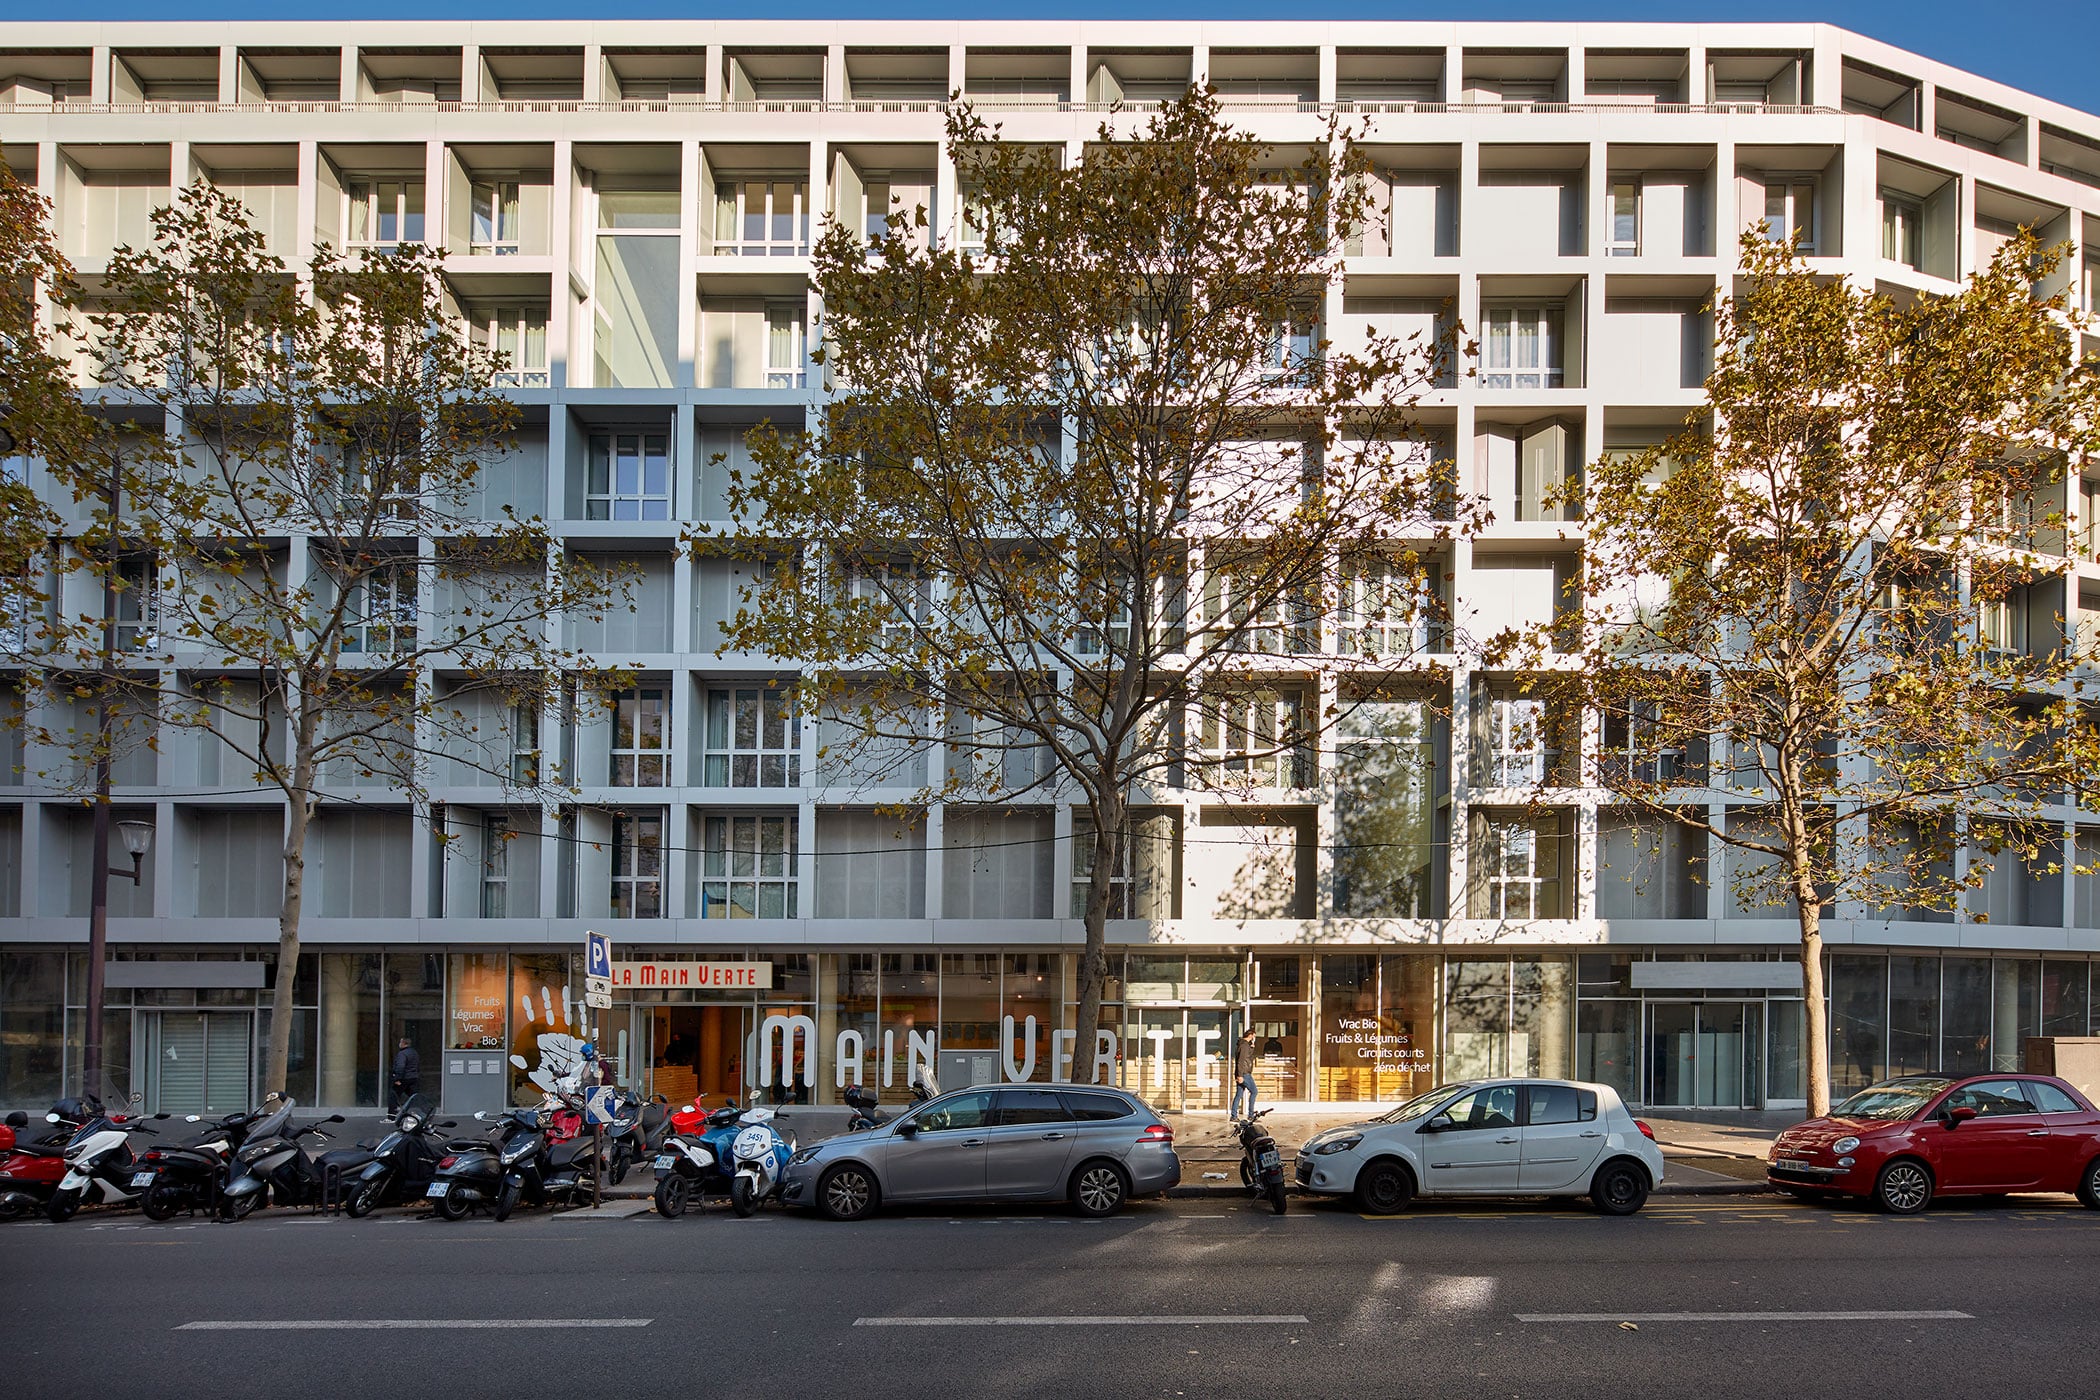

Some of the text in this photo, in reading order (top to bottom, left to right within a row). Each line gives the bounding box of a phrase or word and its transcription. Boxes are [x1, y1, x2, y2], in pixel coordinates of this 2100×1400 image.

[593, 942, 603, 969] P
[612, 965, 756, 985] LA MAIN VERTE
[474, 996, 500, 1007] Fruits
[452, 1009, 494, 1021] Légumes
[463, 1022, 484, 1032] Vrac
[1338, 1018, 1378, 1029] Vrac Bio
[482, 1036, 497, 1046] Bio
[1325, 1033, 1408, 1045] Fruits & Légumes
[760, 1015, 935, 1088] MAIN
[1003, 1014, 1221, 1088] VERTE
[1357, 1047, 1424, 1058] Circuits courts
[1373, 1061, 1431, 1073] Zéro déchet
[747, 1132, 763, 1142] 3451
